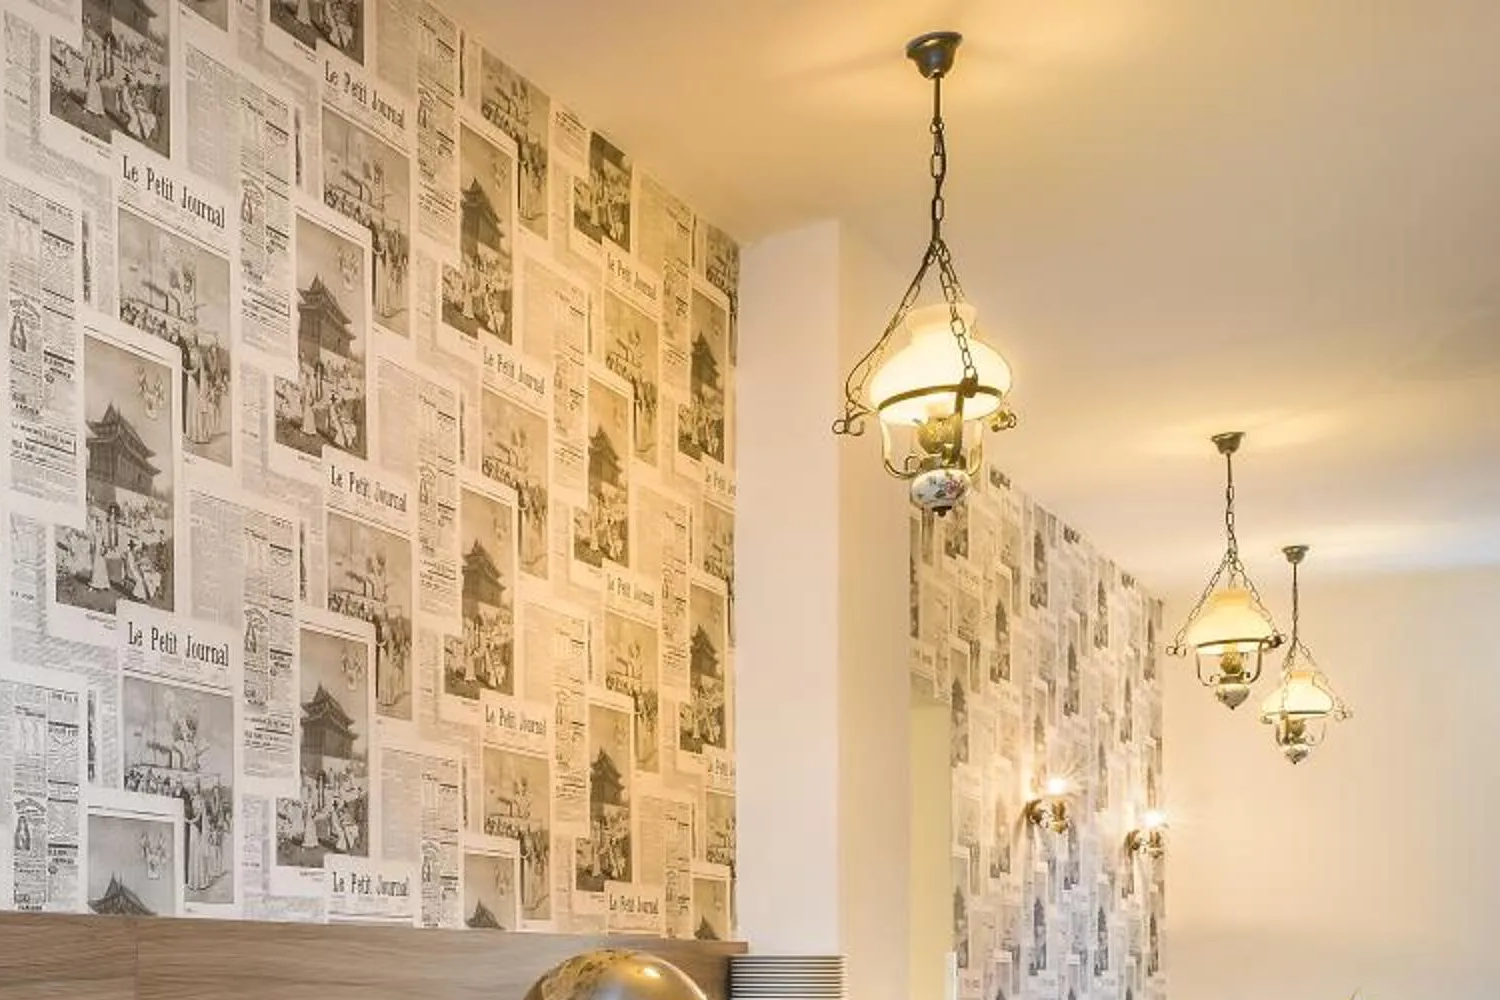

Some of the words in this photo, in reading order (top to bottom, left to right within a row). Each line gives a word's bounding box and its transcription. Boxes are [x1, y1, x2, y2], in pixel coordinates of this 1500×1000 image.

[123, 155, 138, 183] Le
[146, 167, 174, 203] Petit
[182, 186, 225, 229] Journal
[128, 621, 142, 647] Le
[151, 627, 177, 655] Petit
[186, 635, 229, 667] Journal
